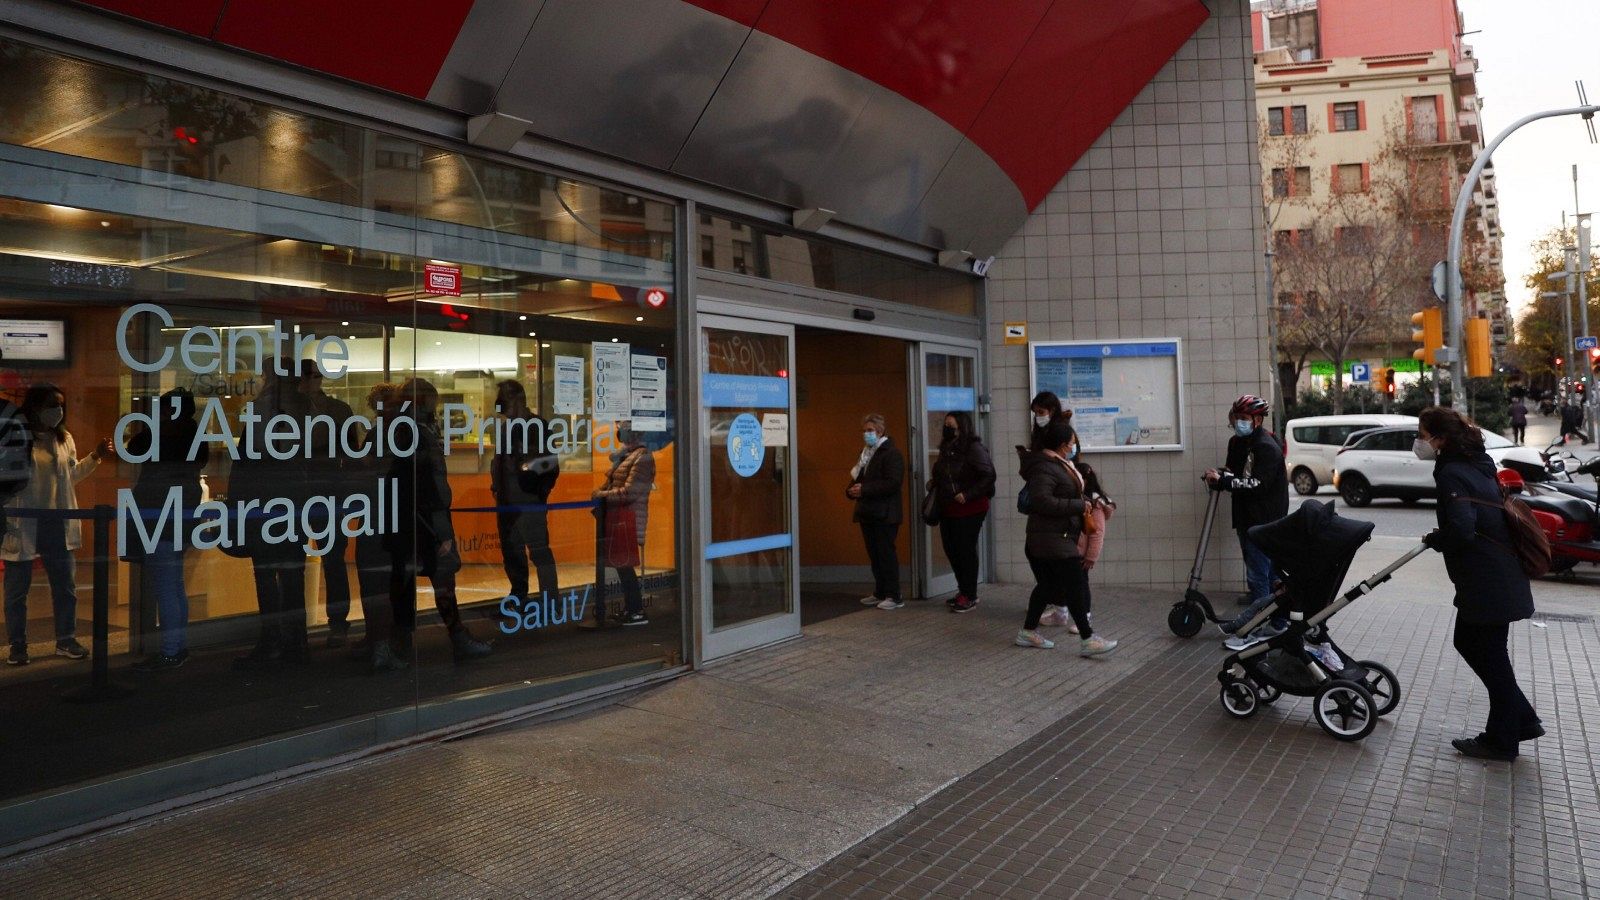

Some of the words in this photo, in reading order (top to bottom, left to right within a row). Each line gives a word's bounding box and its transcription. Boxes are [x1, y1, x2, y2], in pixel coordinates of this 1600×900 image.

[116, 303, 349, 379] Centre
[1354, 365, 1366, 380] P
[114, 396, 419, 463] d'Atenció
[116, 477, 398, 556] Maragall
[500, 584, 592, 634] Salut/
